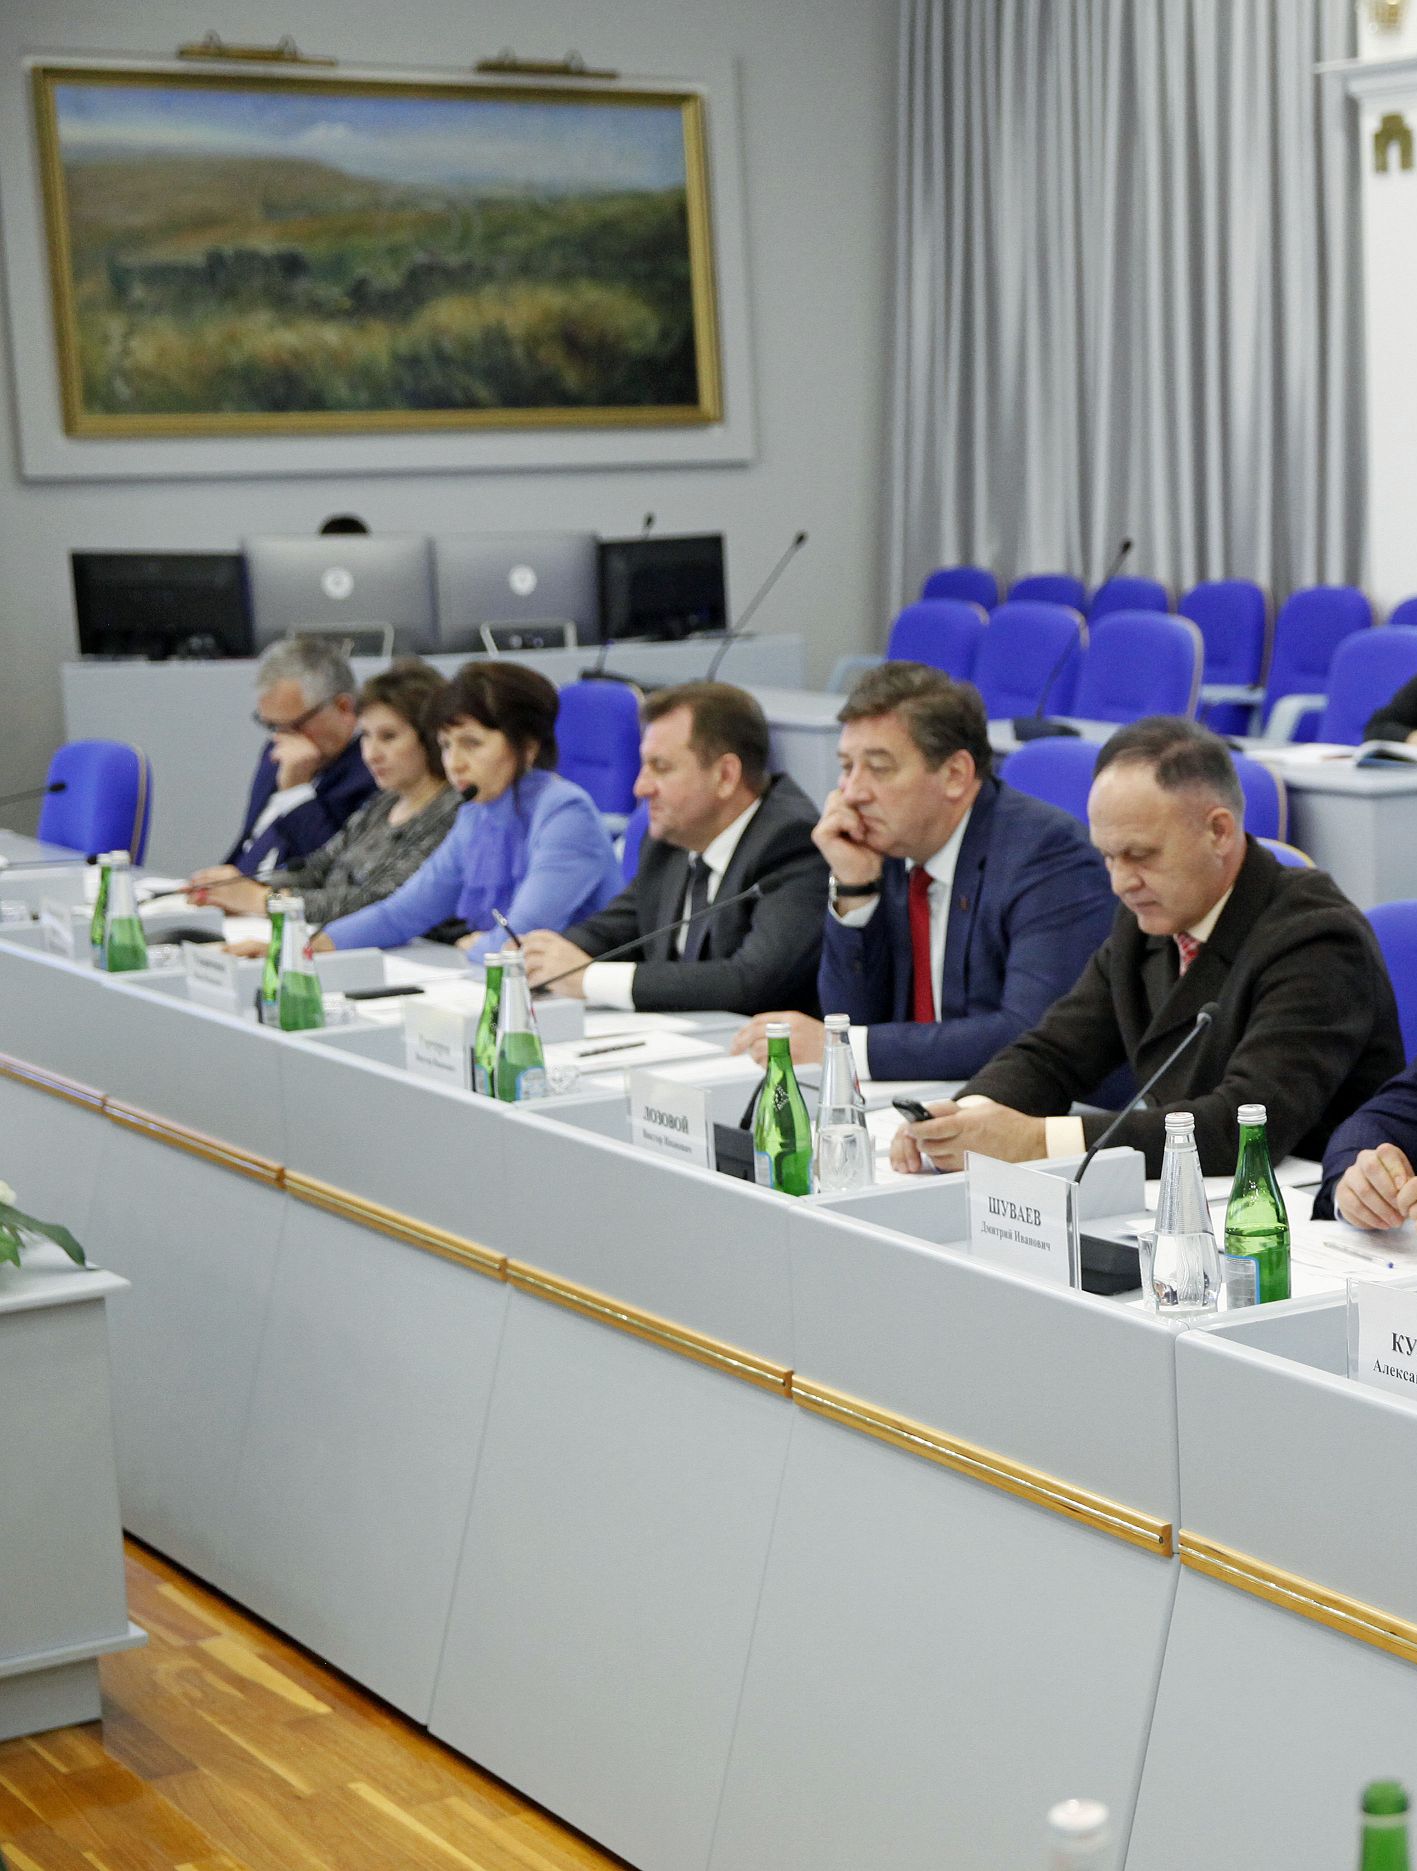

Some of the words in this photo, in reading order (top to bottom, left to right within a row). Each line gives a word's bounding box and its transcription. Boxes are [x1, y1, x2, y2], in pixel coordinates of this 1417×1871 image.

[643, 1105, 689, 1135] ЛОЗОВОЙ
[988, 1196, 1042, 1227] ШУВАЕВ
[980, 1220, 1013, 1241] Дмитрий
[1014, 1230, 1051, 1252] Иванович
